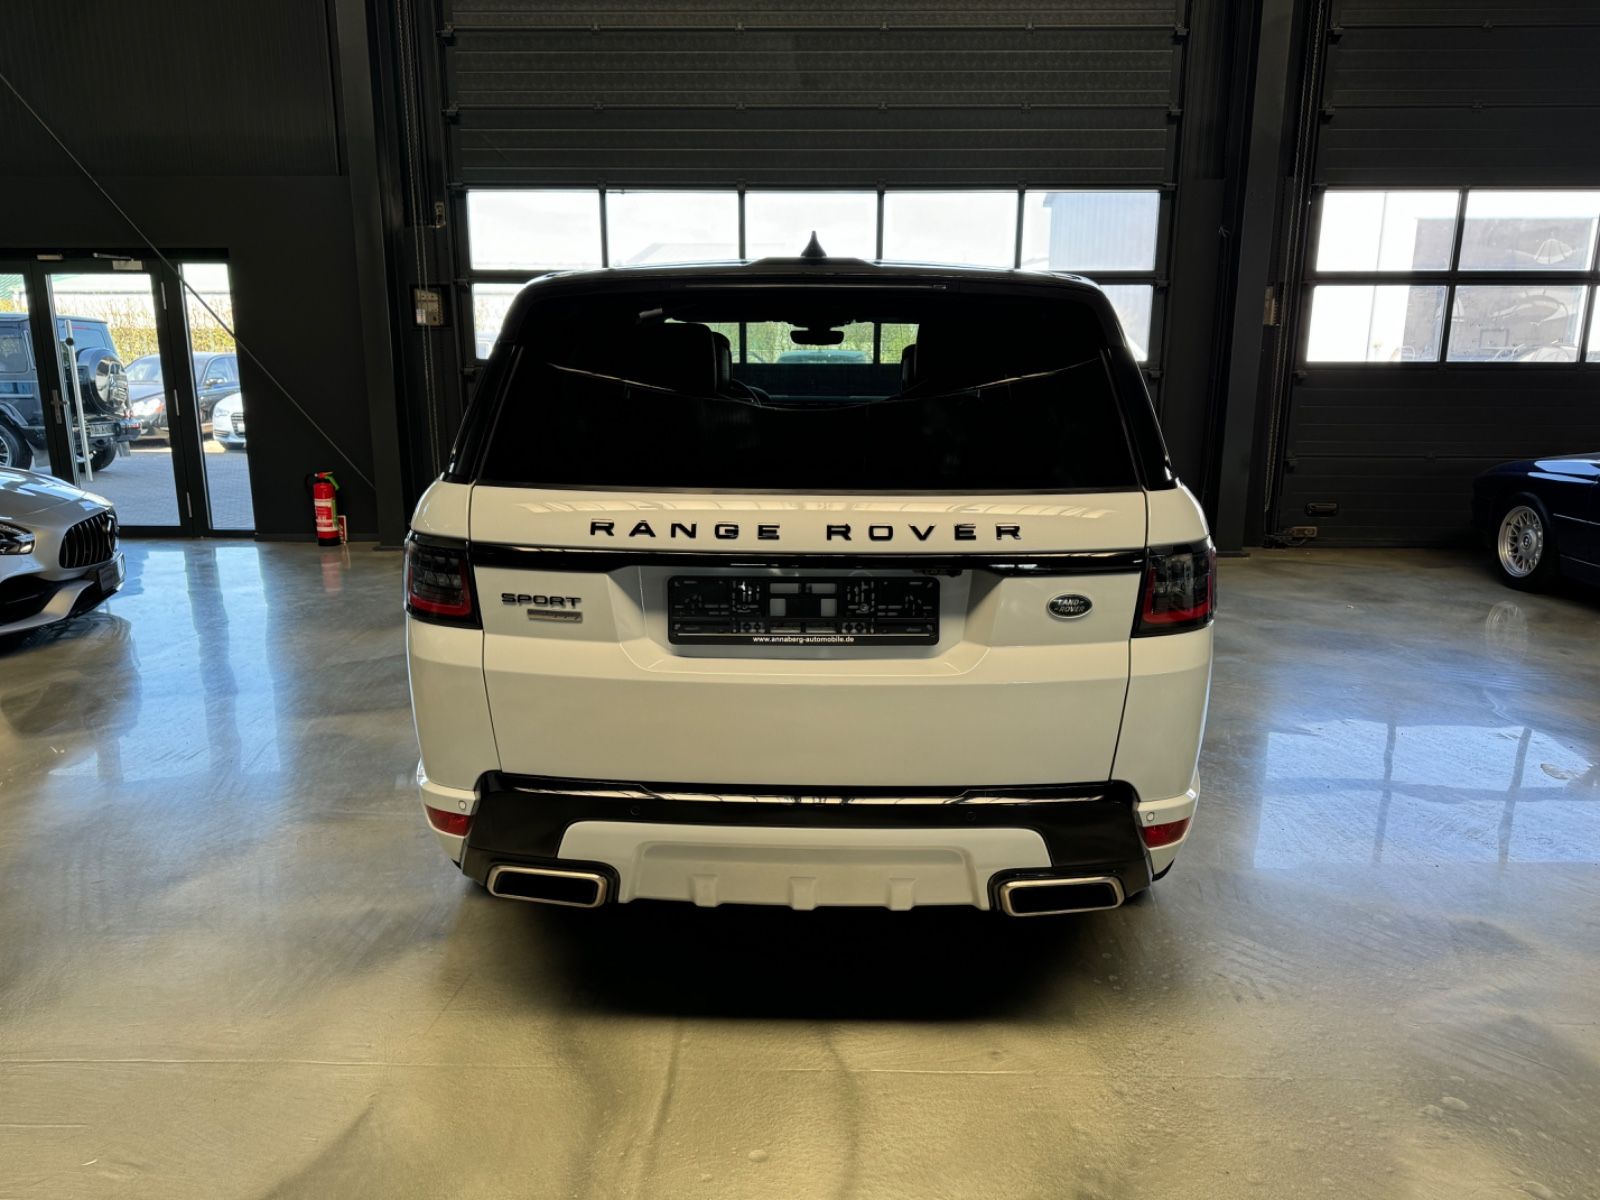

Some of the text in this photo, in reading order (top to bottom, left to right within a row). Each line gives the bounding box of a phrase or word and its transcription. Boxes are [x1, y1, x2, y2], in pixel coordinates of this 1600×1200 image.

[590, 520, 1022, 541] RANGE ROVER
[501, 593, 582, 608] SPORT
[753, 636, 855, 644] www.annaberg-automobile.de
